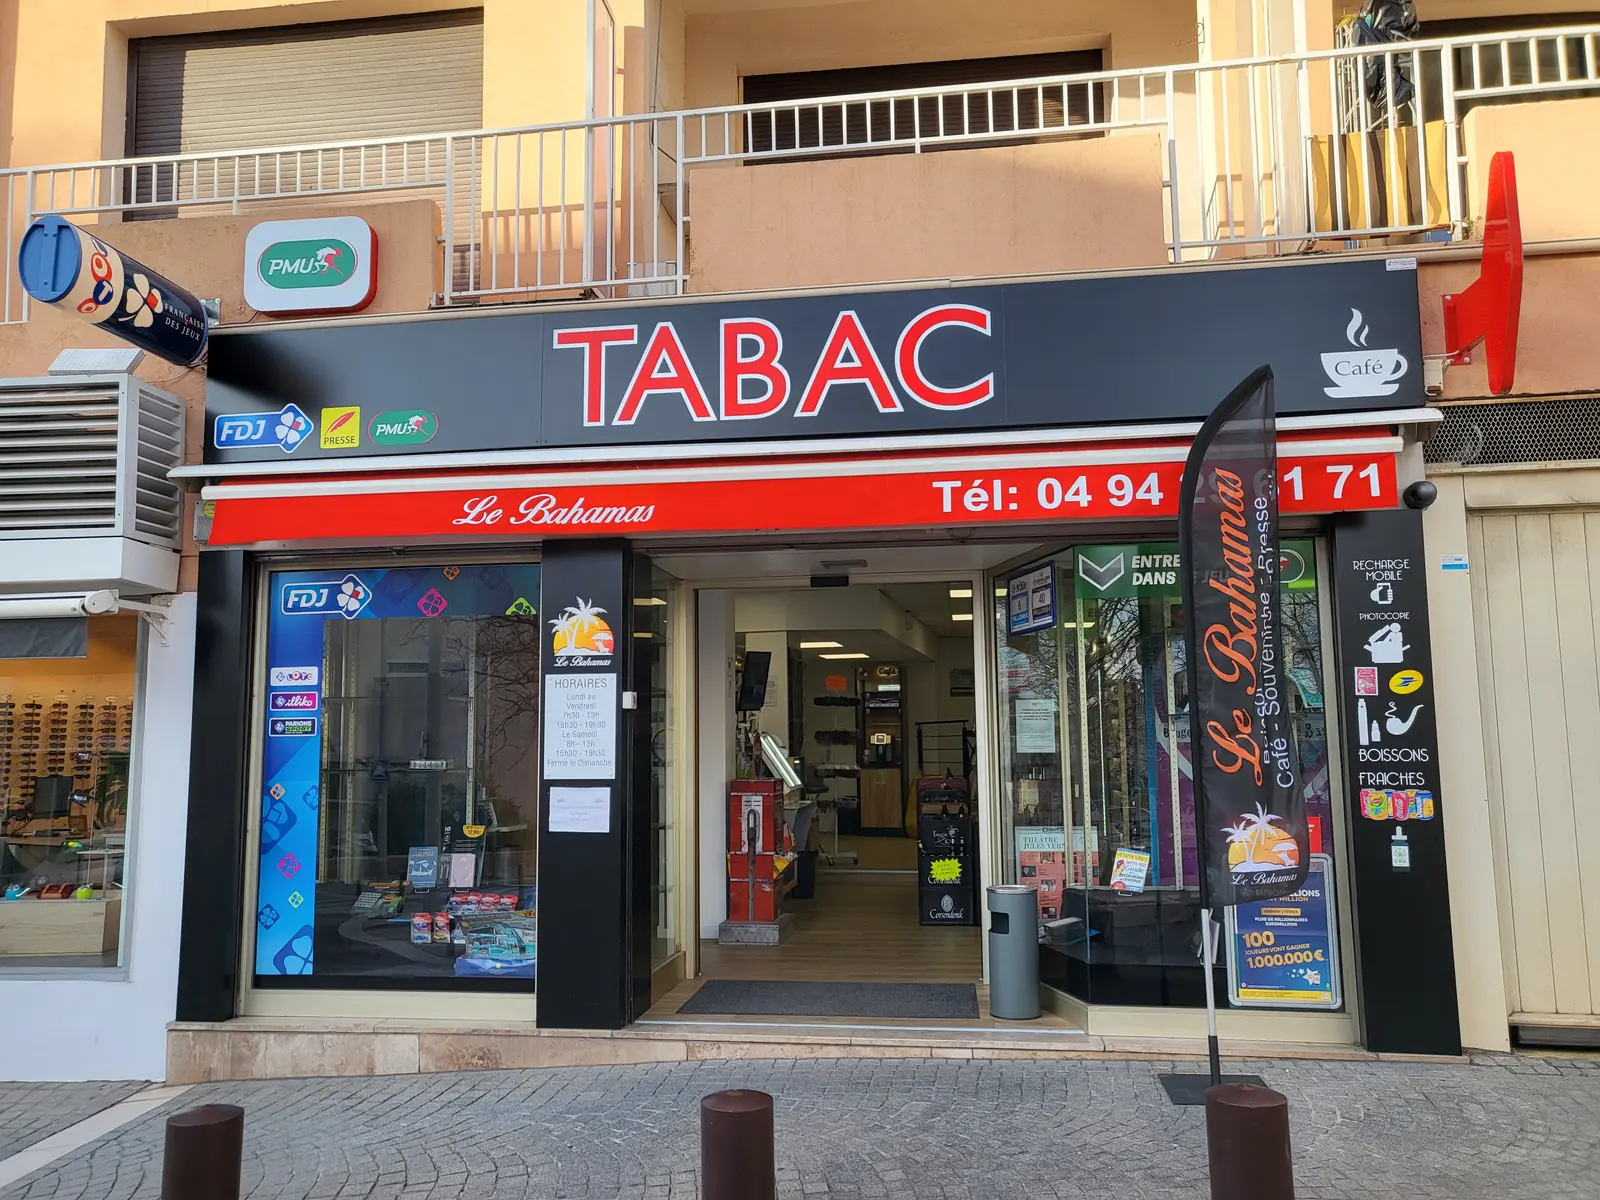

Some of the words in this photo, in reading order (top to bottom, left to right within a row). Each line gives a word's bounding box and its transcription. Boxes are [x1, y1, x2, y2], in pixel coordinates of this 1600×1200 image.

[268, 256, 314, 275] PMU
[164, 302, 205, 330] FRANÇAISE
[165, 317, 180, 330] DES
[181, 326, 201, 342] JEUX
[552, 303, 995, 427] TABAC
[1334, 358, 1383, 378] Café
[220, 419, 267, 441] FDJ
[376, 422, 407, 436] PMU
[324, 435, 356, 445] PRESSE
[932, 478, 1018, 513] Tél:
[1037, 477, 1092, 509] 04
[1107, 472, 1164, 507] 94
[1325, 462, 1382, 499] 71
[452, 495, 503, 525] Le
[510, 493, 656, 525] Bahamas
[1352, 559, 1410, 570] RECHARGE
[1132, 571, 1177, 586] DANS
[1203, 467, 1257, 695] Bahamas
[1365, 570, 1403, 581] MOBILE
[287, 588, 329, 609] FDJ
[1358, 611, 1410, 620] PHOTOCOPIE
[553, 656, 569, 667] Le
[569, 655, 611, 667] Bahamas
[878, 667, 898, 676] Café
[554, 678, 608, 689] HORAIRES
[284, 695, 313, 707] illiko
[566, 693, 586, 701] Lundi
[566, 702, 596, 710] Vendredi
[562, 711, 580, 719] 7h30
[587, 711, 600, 719] 13h
[556, 721, 578, 729] 15h30
[584, 721, 606, 729] 19h30
[572, 730, 598, 738] Samedi
[1163, 727, 1192, 739] Buge
[556, 749, 578, 757] 15h30
[584, 749, 606, 757] 19h30
[1207, 708, 1263, 787] Le
[1358, 748, 1430, 762] BOISSONS
[547, 759, 568, 767] Fermé
[577, 759, 612, 767] Dimanche
[1270, 737, 1294, 788] Café
[1358, 771, 1425, 786] FRAICHES
[1023, 835, 1059, 843] THÉÂTRE
[1229, 872, 1248, 886] Le
[1250, 870, 1298, 885] Bahamas
[1242, 930, 1275, 948] 100
[1244, 946, 1270, 956] JOUEURS
